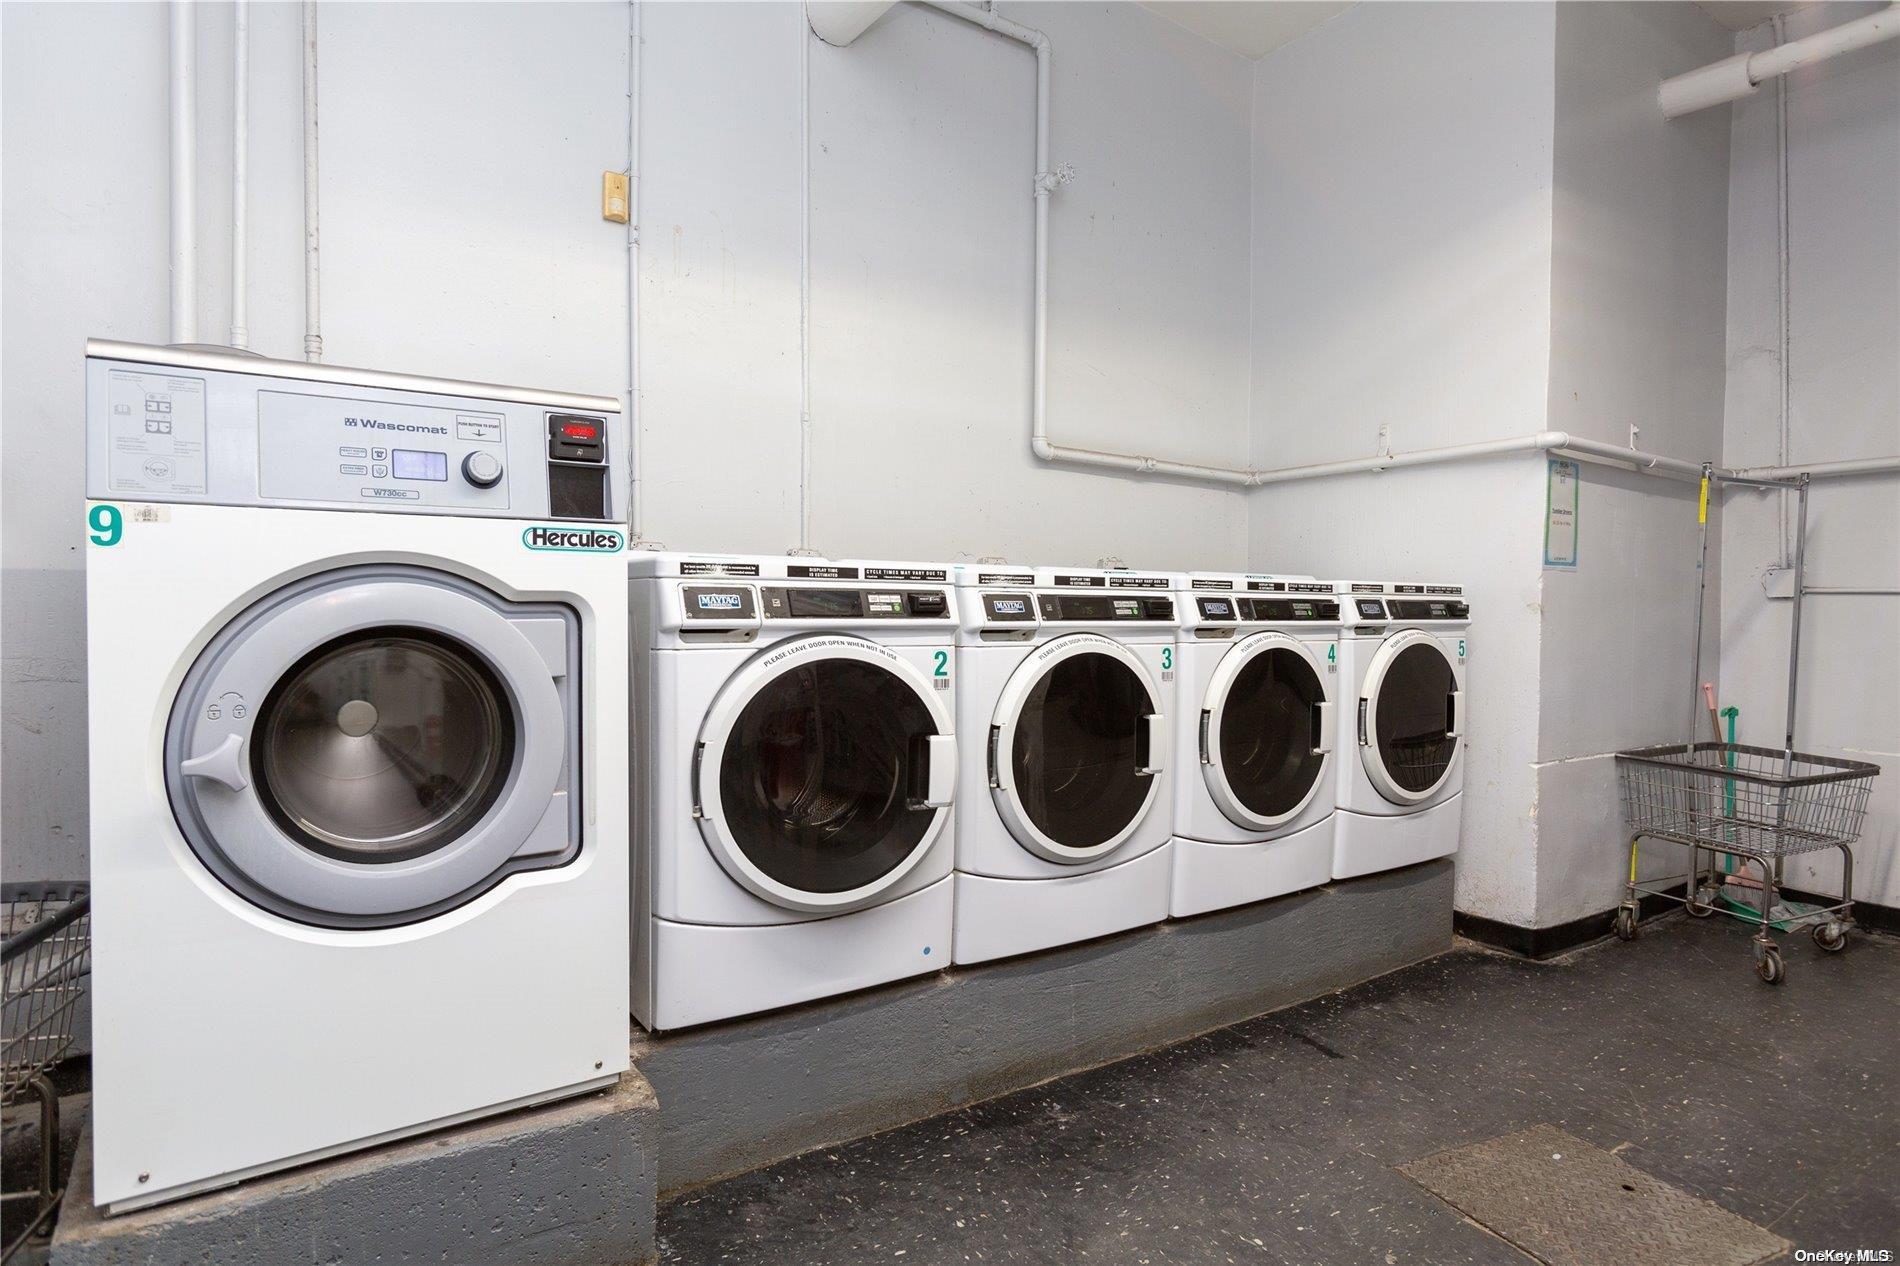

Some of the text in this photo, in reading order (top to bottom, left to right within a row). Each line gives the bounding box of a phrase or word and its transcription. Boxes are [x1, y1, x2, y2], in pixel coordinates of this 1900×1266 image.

[360, 418, 448, 435] Wascomat
[373, 488, 408, 498] W730cc
[88, 504, 123, 547] 9
[532, 527, 618, 549] Hercules
[701, 595, 739, 605] MAYTAG
[763, 651, 787, 668] PLEASE
[787, 644, 808, 656] LEAVE
[808, 640, 827, 649] DOOR
[846, 641, 865, 649] WHEN
[865, 644, 878, 652] NOT
[886, 651, 897, 662] USE
[1038, 647, 1055, 661] PLEASE
[1055, 641, 1068, 651] LEAVE
[1161, 647, 1172, 670] 3
[1328, 643, 1336, 664] 4
[1458, 640, 1465, 658] 5
[934, 650, 948, 676] 2
